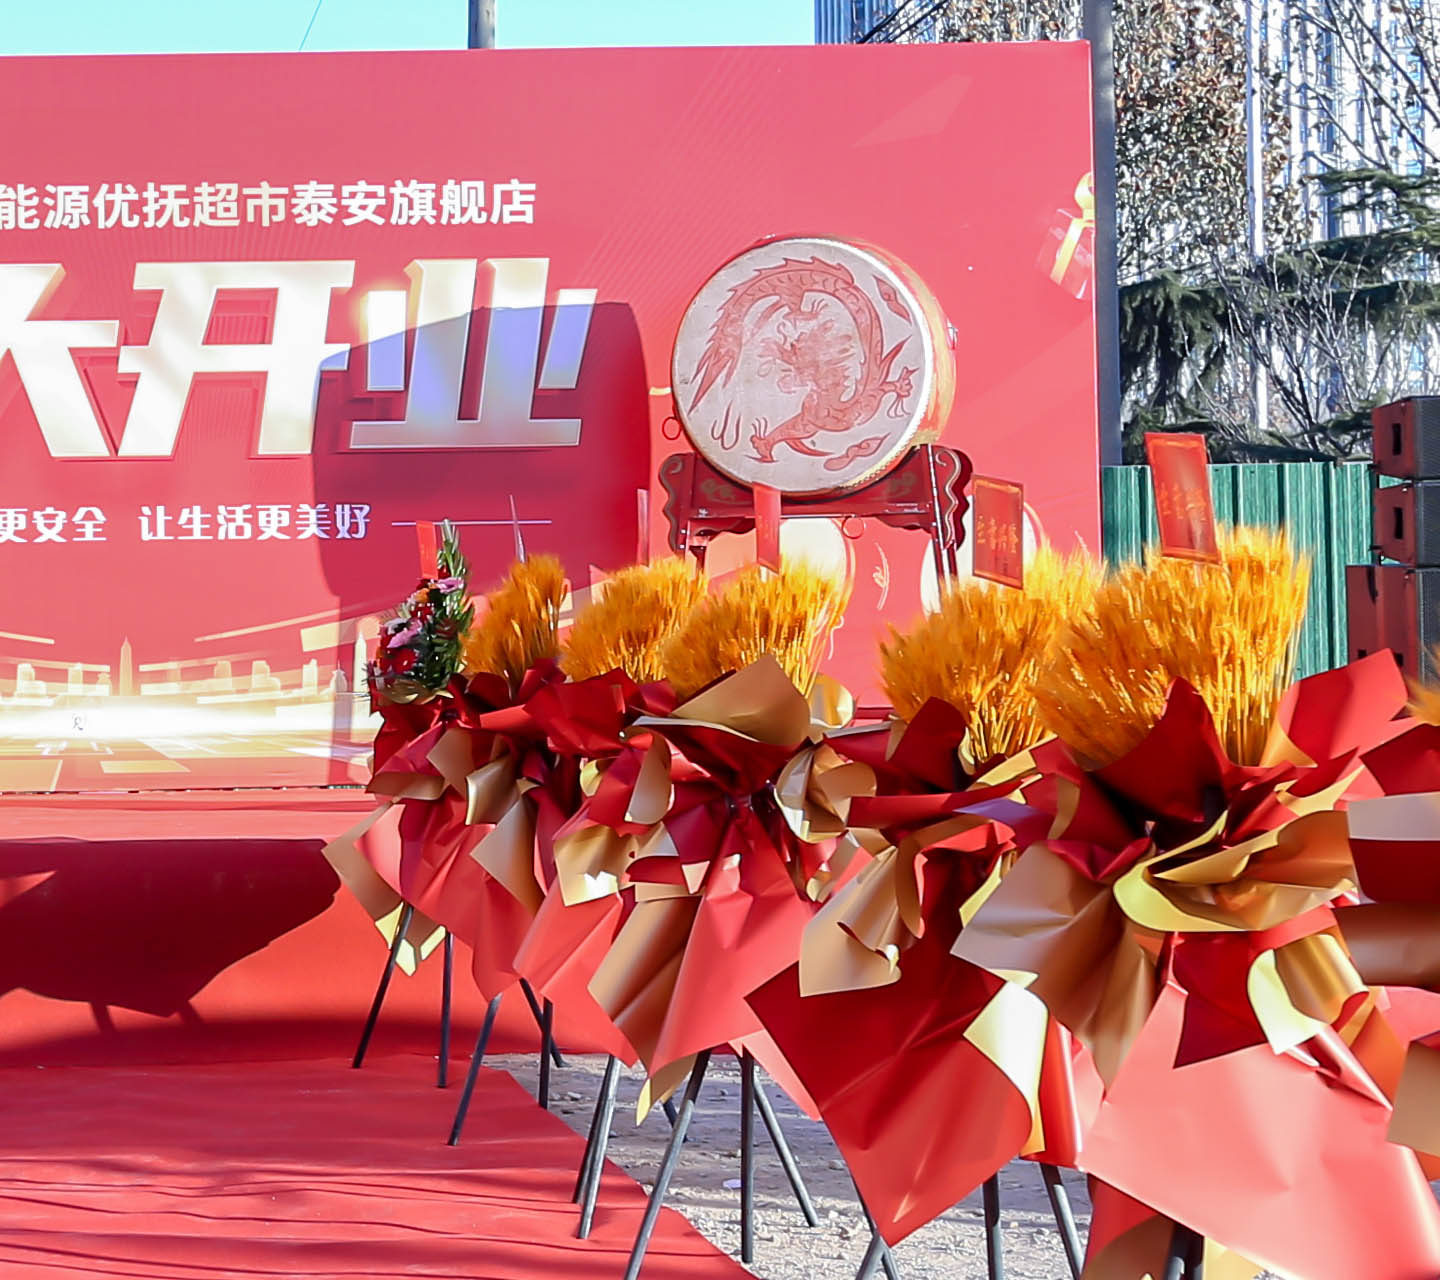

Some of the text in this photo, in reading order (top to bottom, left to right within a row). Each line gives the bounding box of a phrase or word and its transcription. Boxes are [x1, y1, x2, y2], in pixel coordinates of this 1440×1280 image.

[138, 503, 372, 545] 让生活更美好
